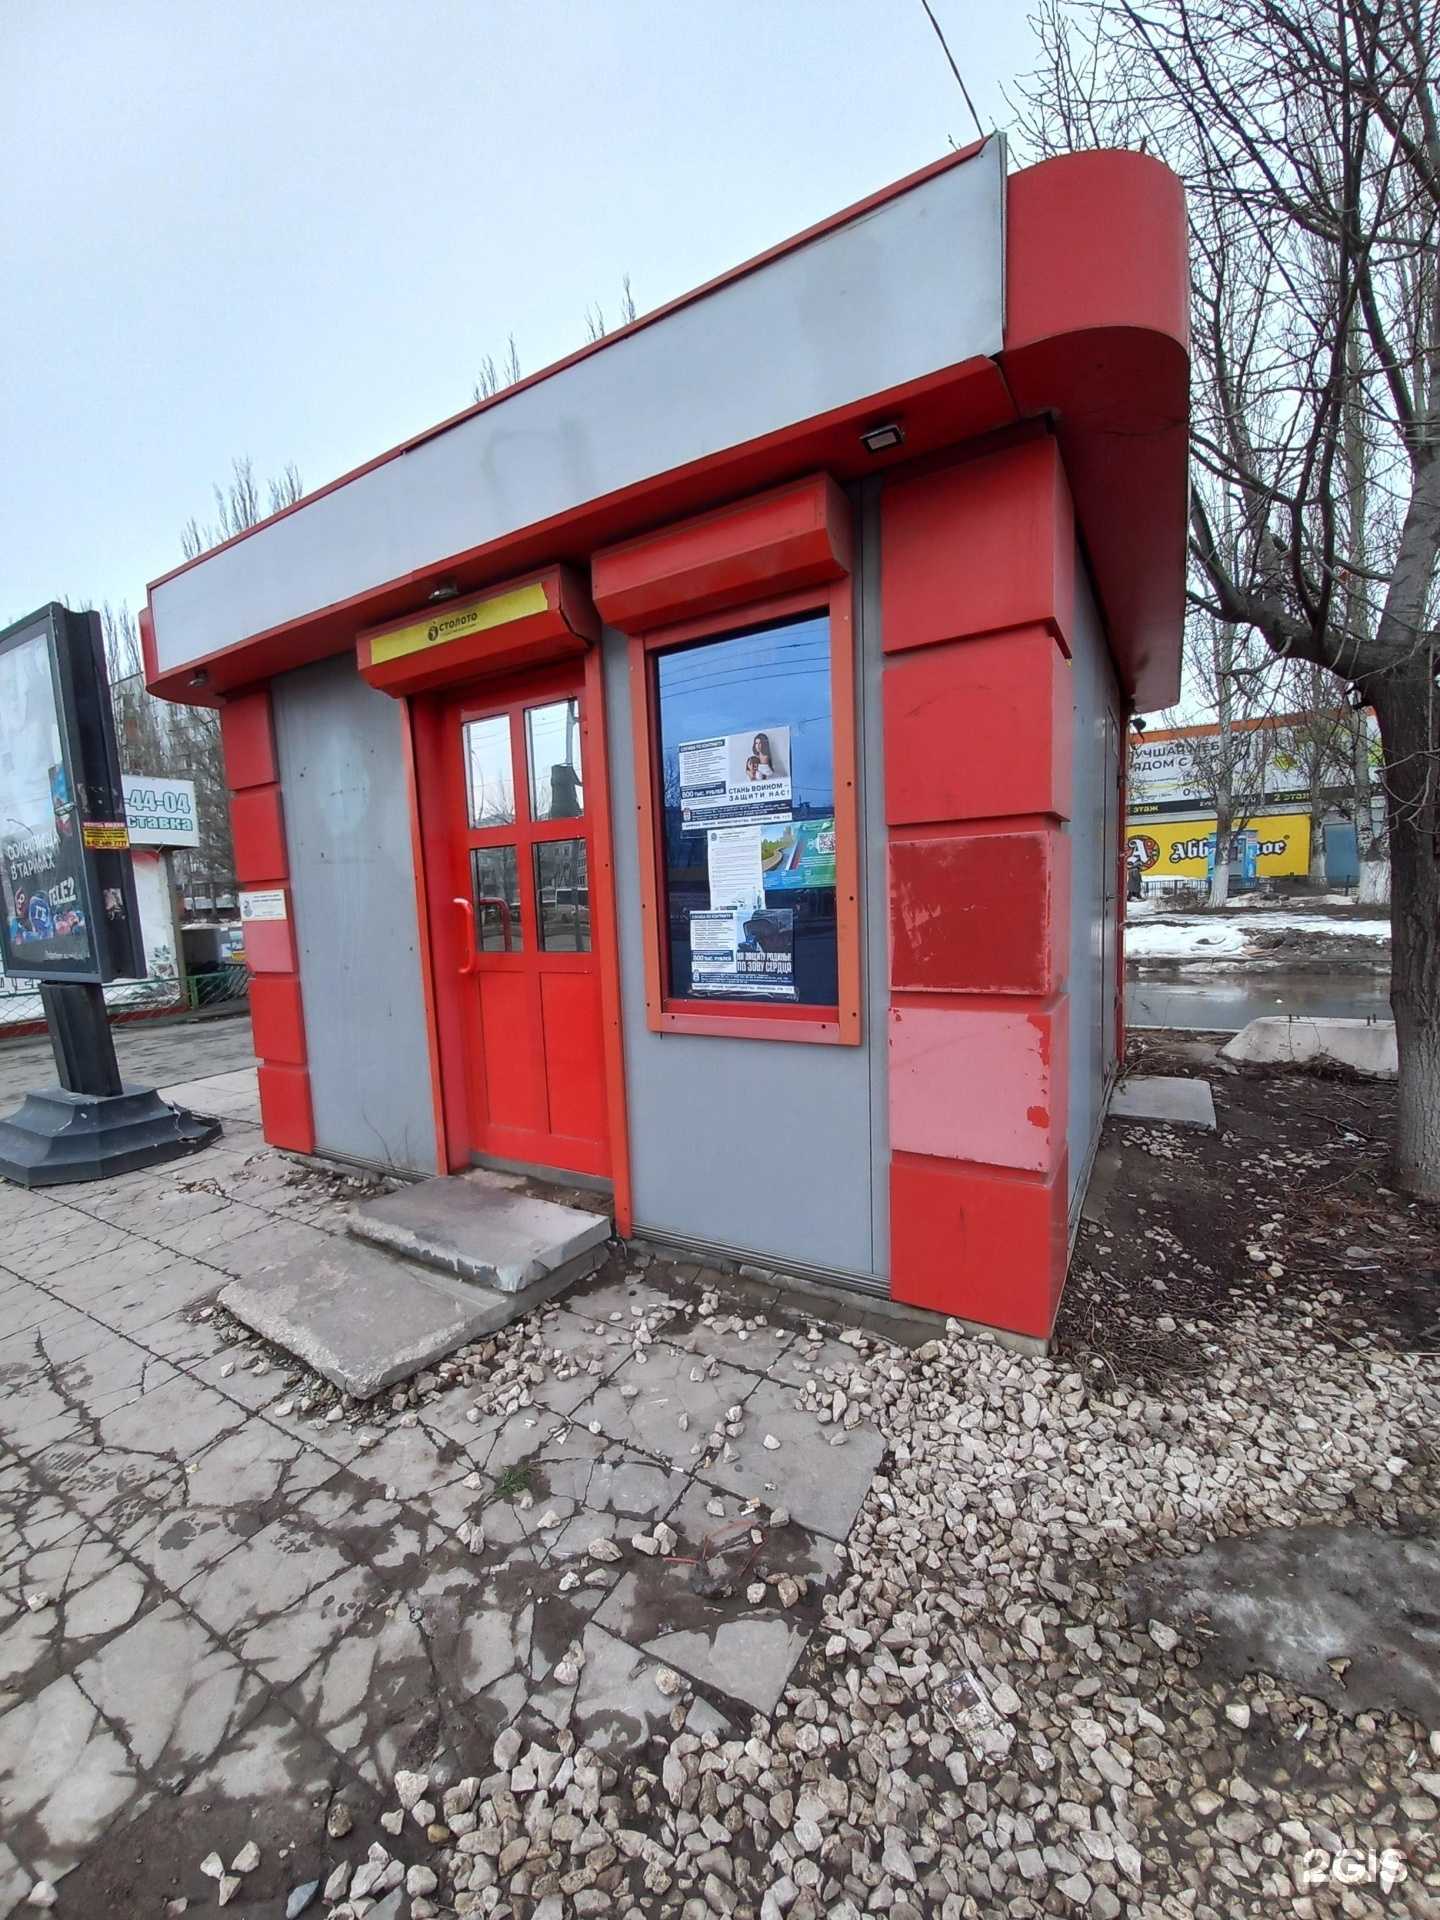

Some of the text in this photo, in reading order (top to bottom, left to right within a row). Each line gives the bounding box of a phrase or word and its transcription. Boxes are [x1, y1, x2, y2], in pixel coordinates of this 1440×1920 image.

[439, 612, 478, 632] СТОЛОТО
[1131, 760, 1174, 772] ЯДОМ
[729, 786, 750, 795] СТАНЬ
[751, 783, 783, 792] ВОИНОМ
[729, 790, 790, 801] ЗАЩИТИ НАС!
[126, 815, 193, 831] ставка
[48, 876, 76, 905] TELE2
[737, 961, 746, 971] ПО
[747, 961, 765, 972] ЗОВУ
[765, 962, 792, 974] СЕРДЦА
